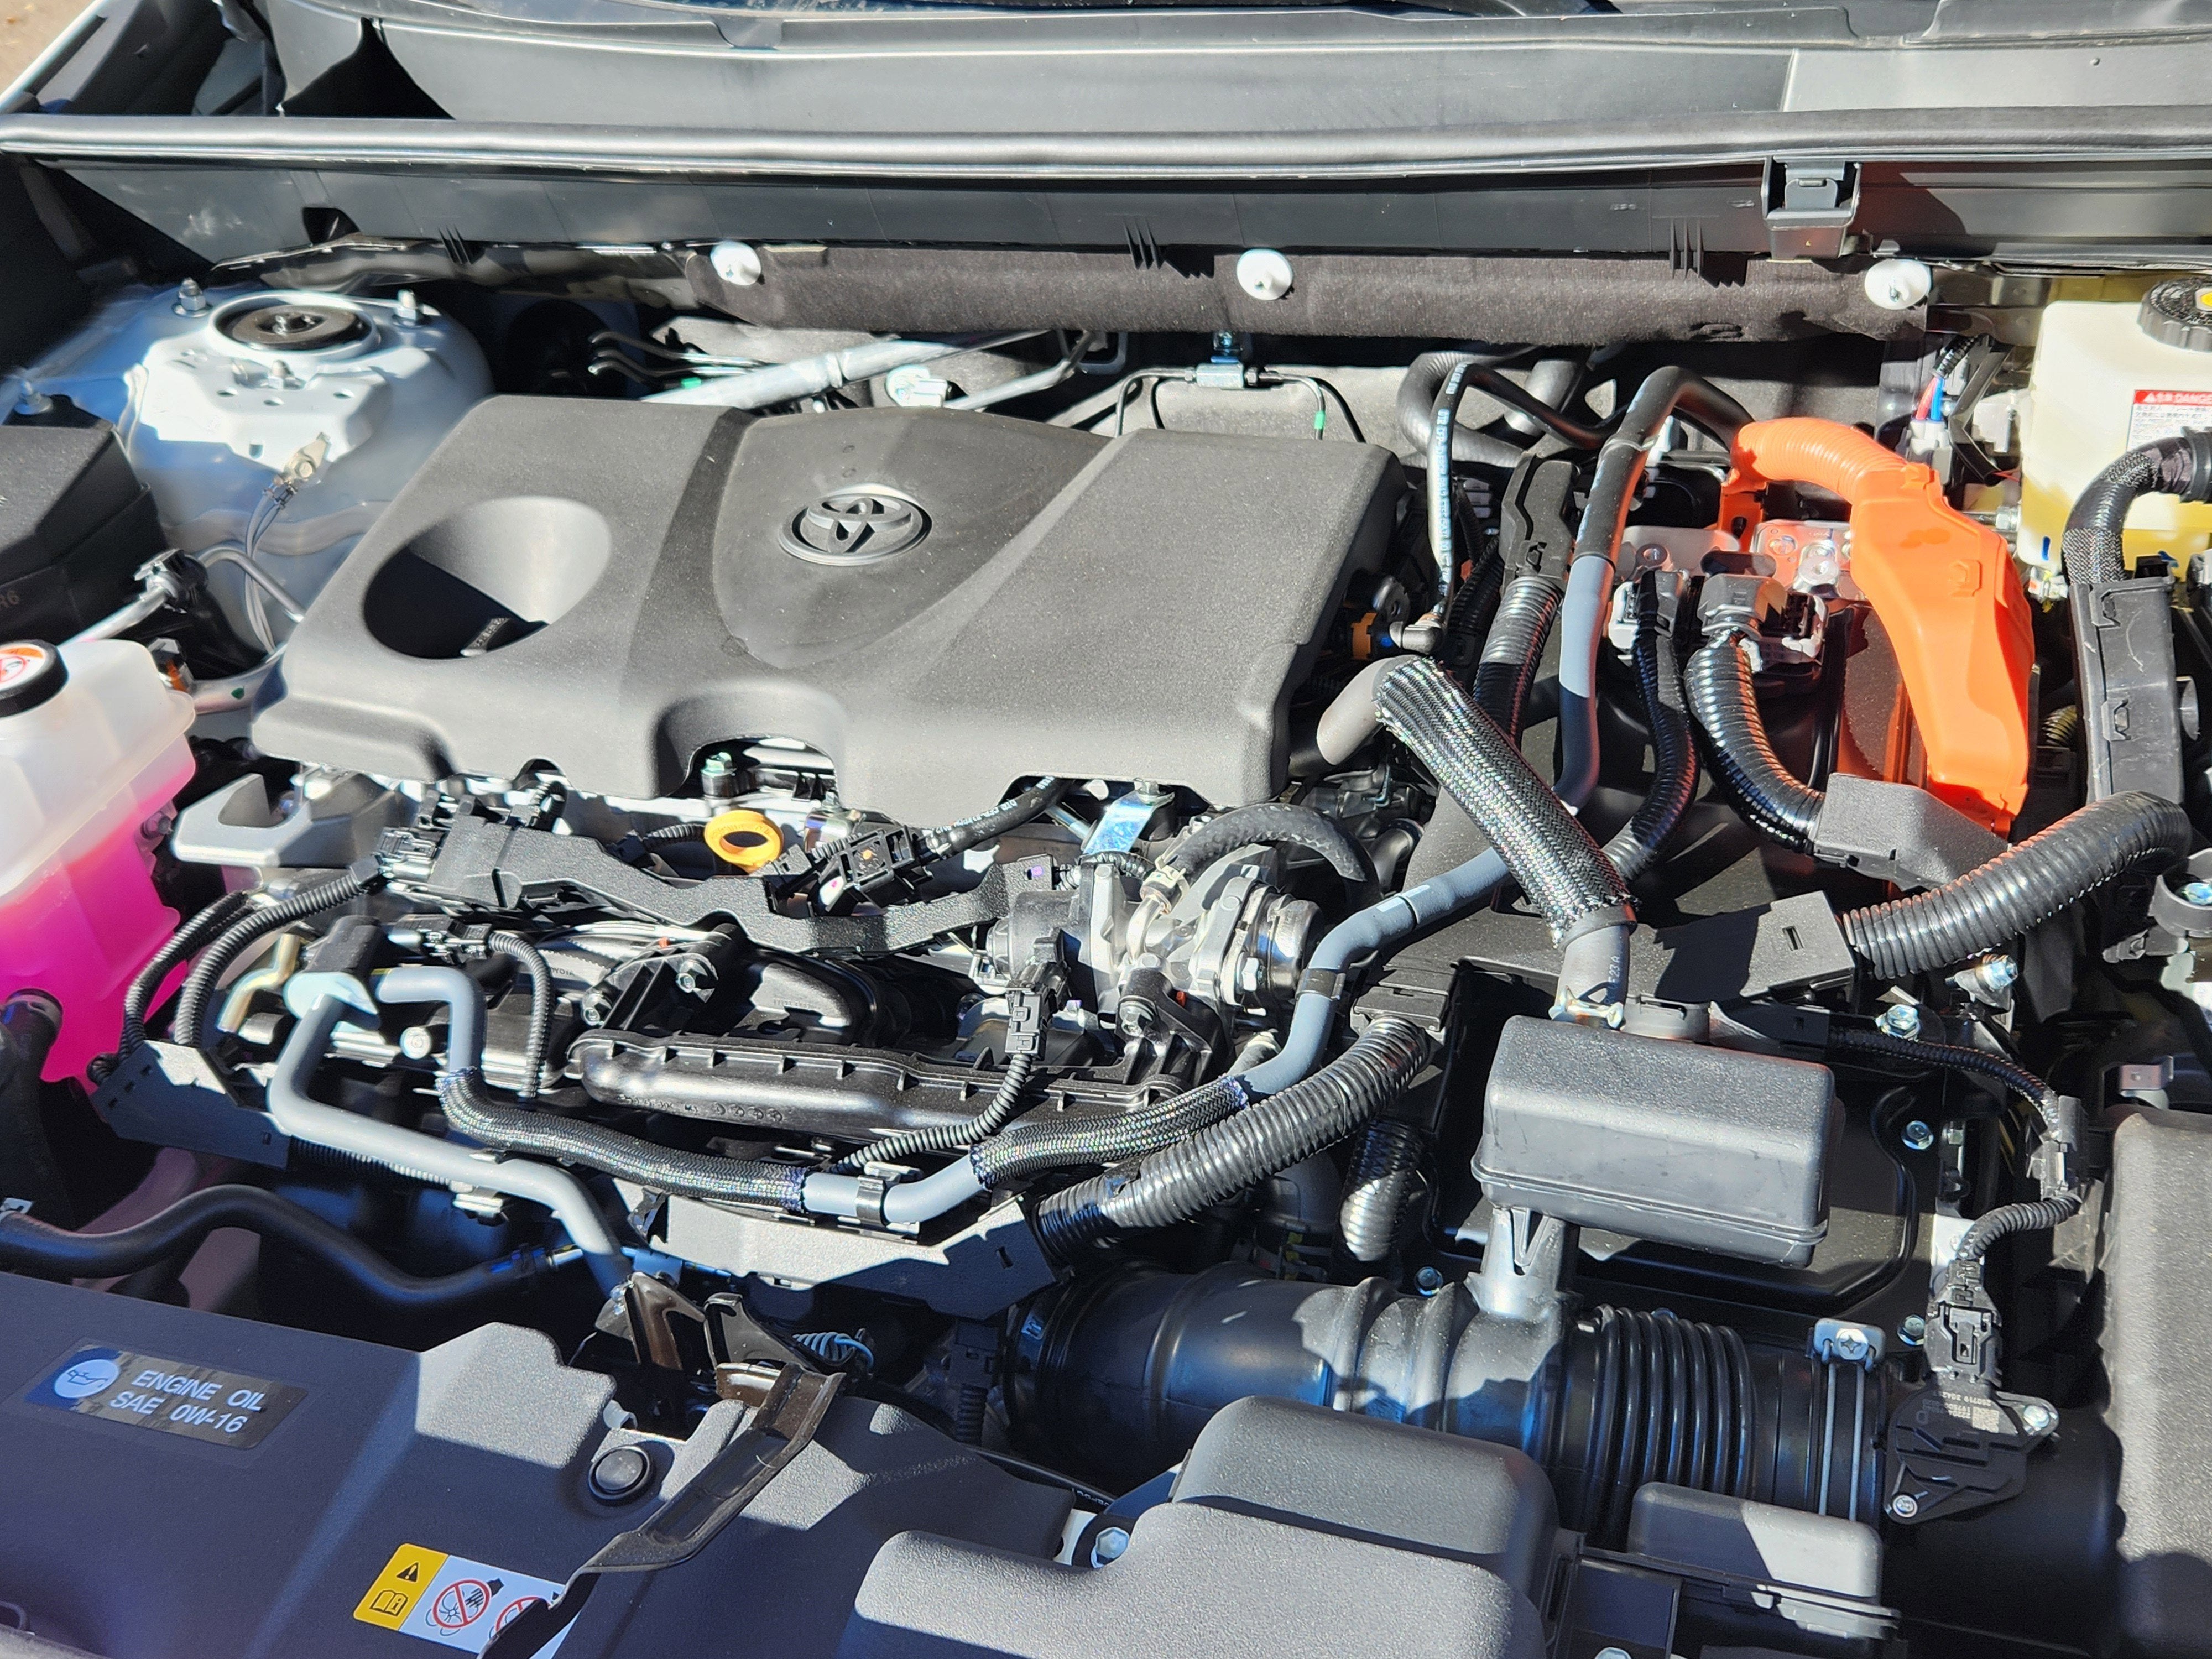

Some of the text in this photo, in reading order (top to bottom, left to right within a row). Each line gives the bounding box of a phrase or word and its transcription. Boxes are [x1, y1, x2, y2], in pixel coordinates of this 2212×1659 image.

[132, 1369, 265, 1412] ENGINE OIL
[110, 1391, 248, 1433] SAE 0W-16
